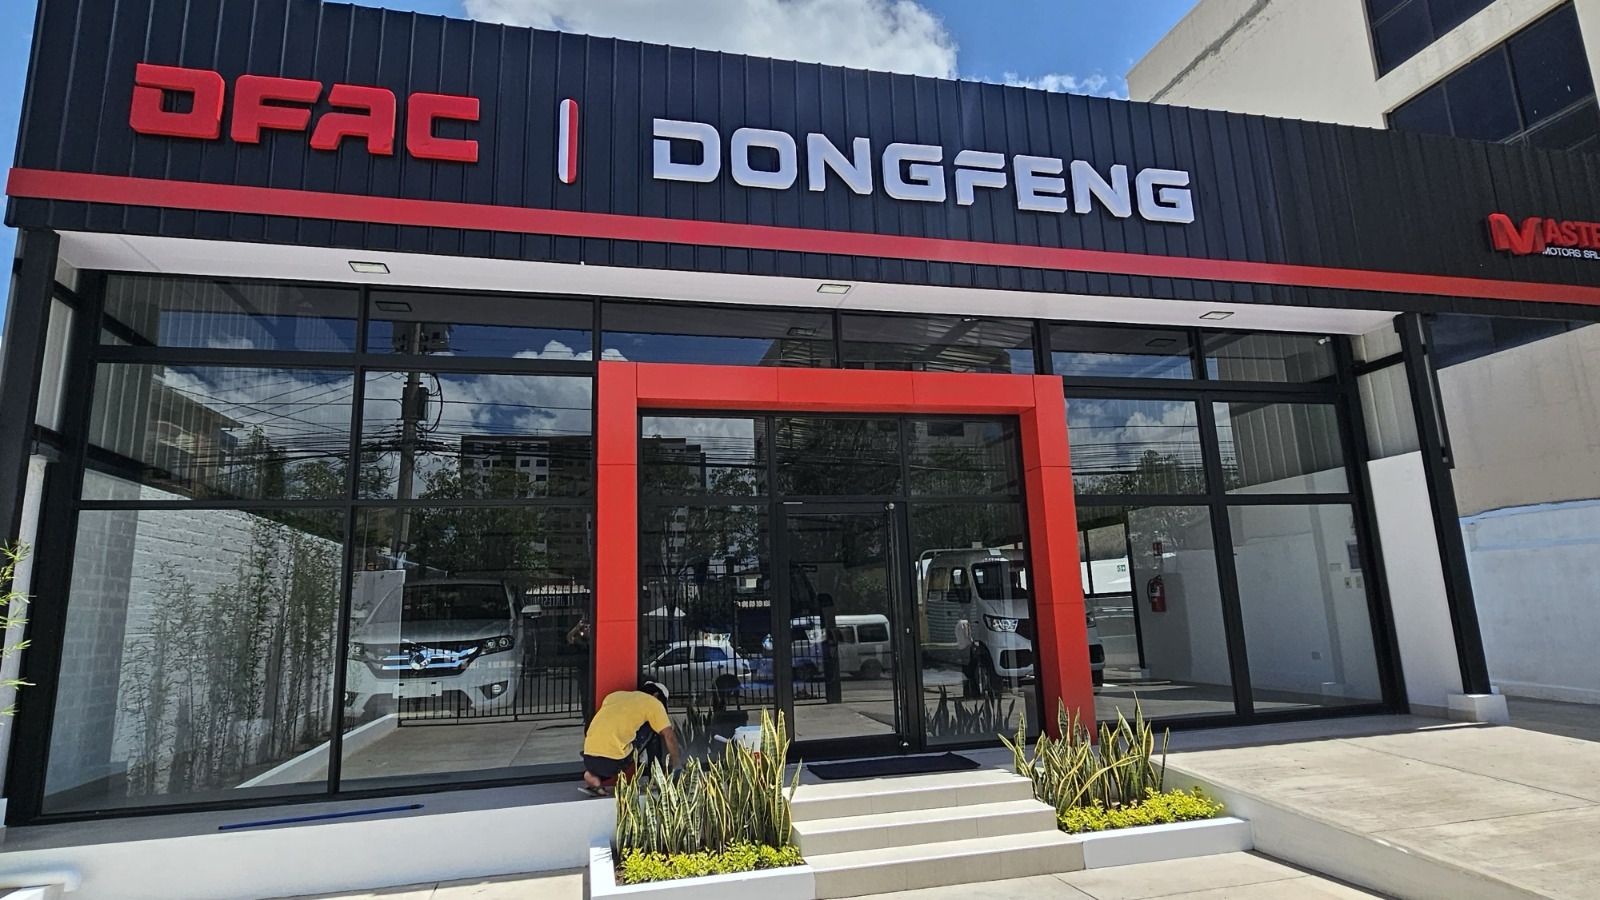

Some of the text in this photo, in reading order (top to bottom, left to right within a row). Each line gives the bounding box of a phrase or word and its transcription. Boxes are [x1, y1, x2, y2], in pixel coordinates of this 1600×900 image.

[129, 63, 480, 163] DFAC
[652, 118, 1195, 224] DONGFENG
[1543, 246, 1581, 258] MOTORS
